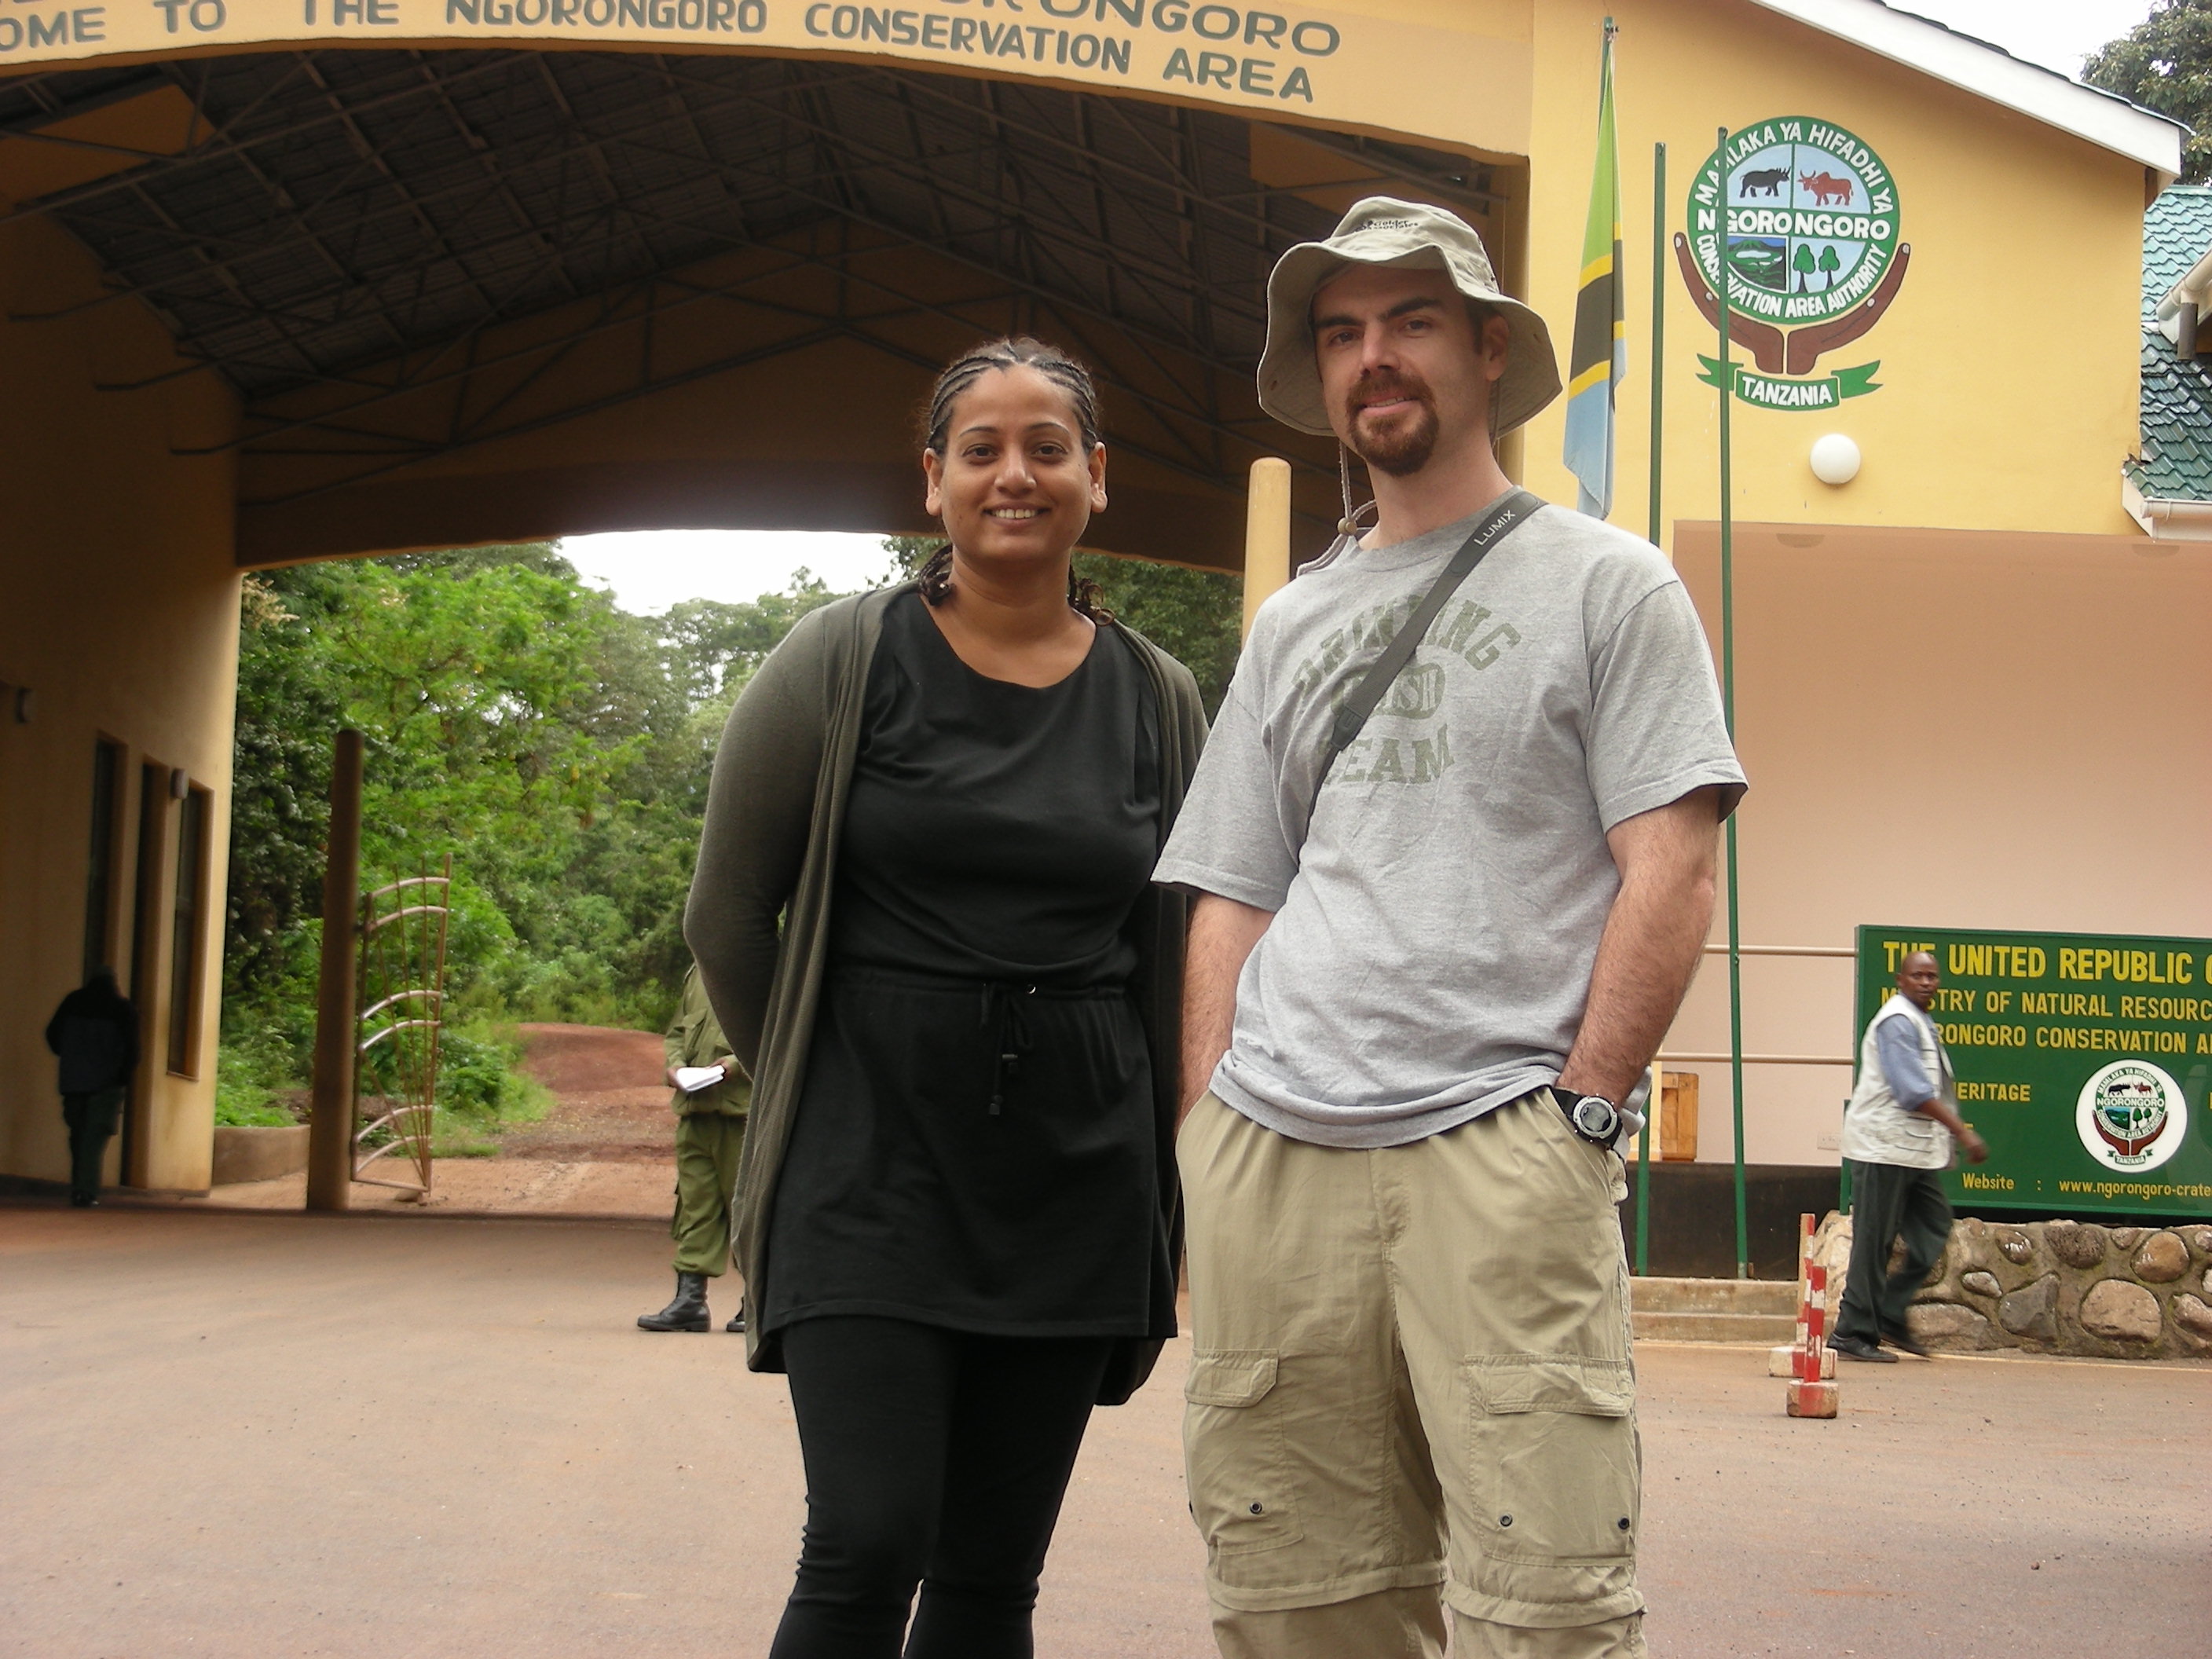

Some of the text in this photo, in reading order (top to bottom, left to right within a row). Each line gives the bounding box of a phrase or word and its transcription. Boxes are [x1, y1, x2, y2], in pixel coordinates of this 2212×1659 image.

[154, 0, 226, 33] TO
[447, 0, 768, 33] NGORONGORO
[805, 3, 1131, 75] CONSERVATION
[1163, 48, 1313, 103] AREA
[1695, 122, 1894, 214] MALAKA YA HIFADHI YA
[1697, 209, 1891, 240] NGORONGORO
[1785, 295, 1826, 318] AREA
[1826, 243, 1887, 313] AUTHORITY
[1741, 375, 1833, 406] TANZANIA
[1474, 509, 1516, 546] LUMIX
[1318, 723, 1455, 785] EAM
[1948, 943, 2046, 978] UNITED
[2059, 947, 2193, 985] REPUBLIC
[1986, 991, 2012, 1013] OF
[2021, 991, 2114, 1017] NATURAL
[2036, 1026, 2187, 1054] CONSERVATION
[2097, 1097, 2165, 1108] NGORONGORO
[2115, 1156, 2145, 1165] TANZANIA
[1962, 1172, 2015, 1190] Website
